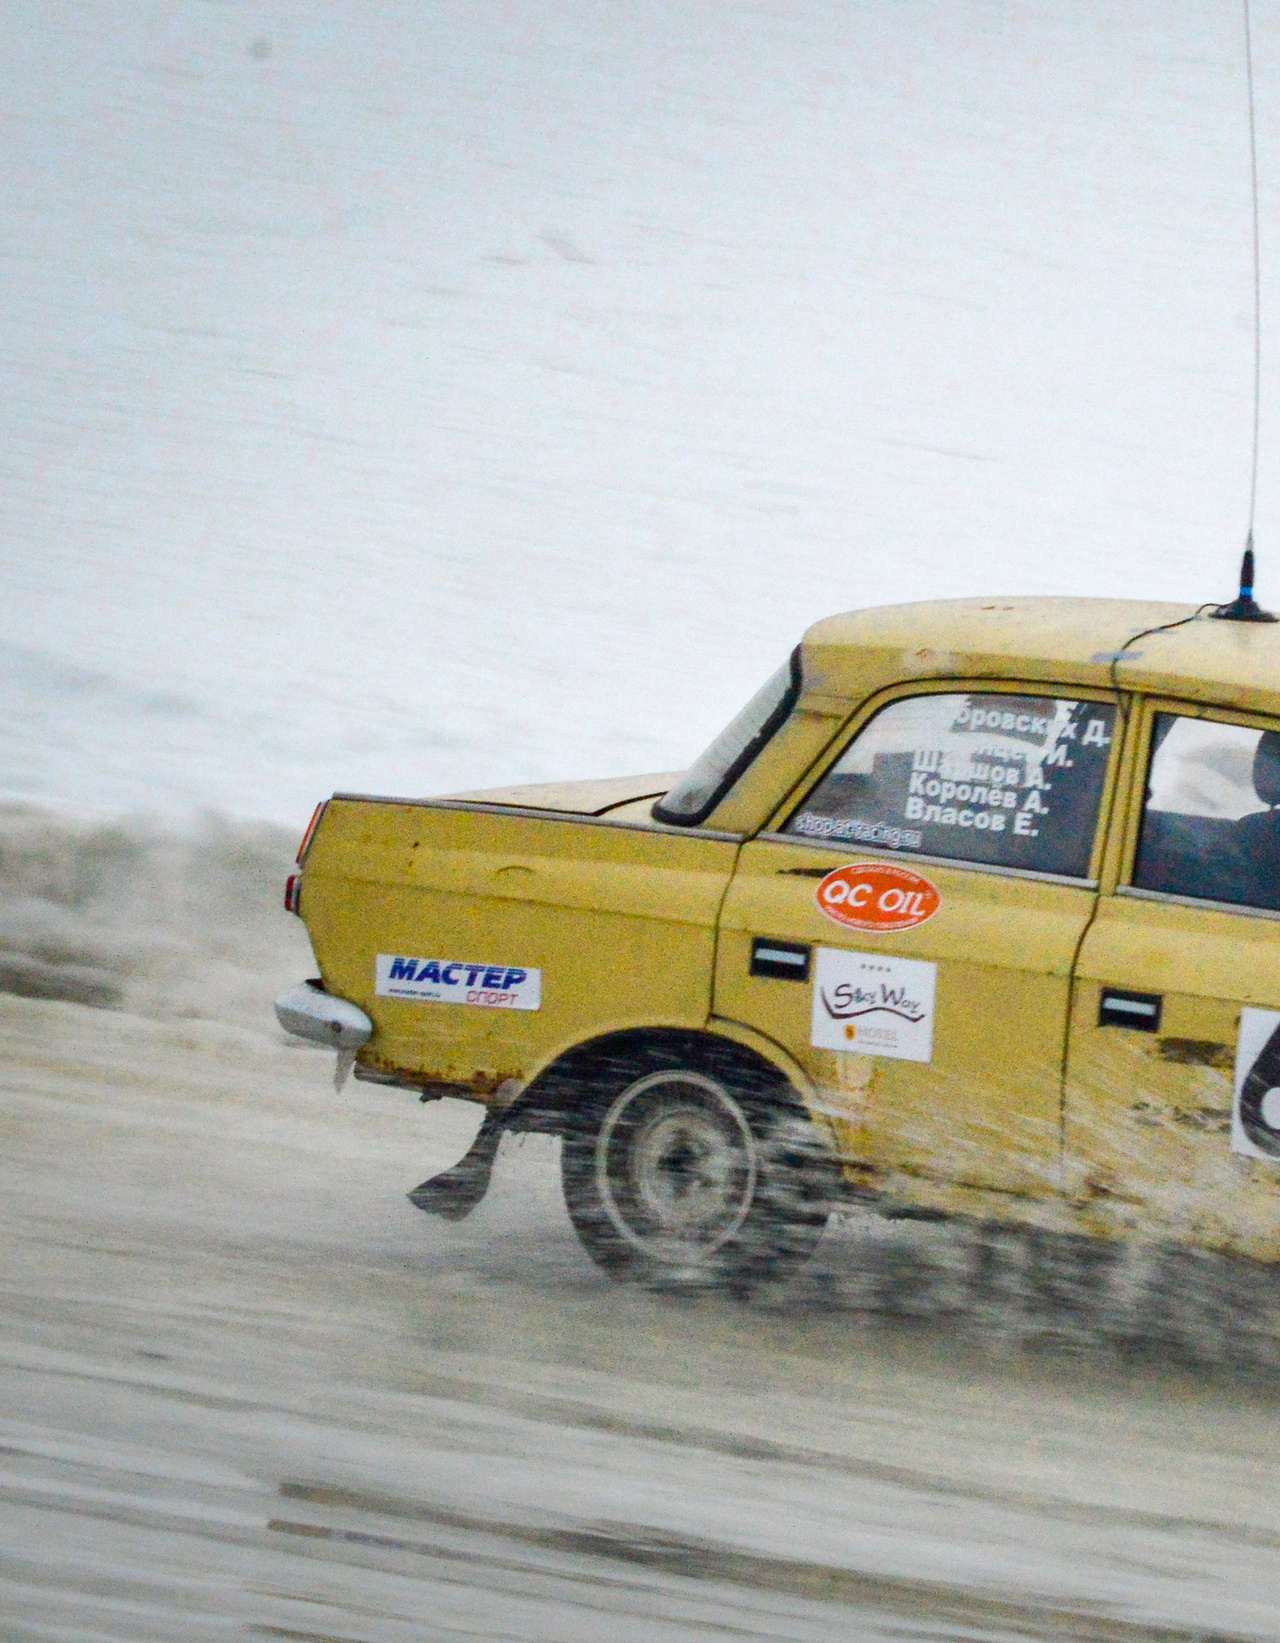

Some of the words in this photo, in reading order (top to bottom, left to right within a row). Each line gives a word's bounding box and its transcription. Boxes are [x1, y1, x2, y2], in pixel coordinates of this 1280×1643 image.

[905, 796, 1007, 832] Власов
[1013, 811, 1039, 838] Е.
[1022, 790, 1050, 816] А.
[823, 879, 873, 908] QC
[877, 888, 926, 917] OIL
[389, 957, 528, 990] МАСТЕР
[466, 990, 519, 1006] СПОРТ
[880, 982, 921, 1014] Way
